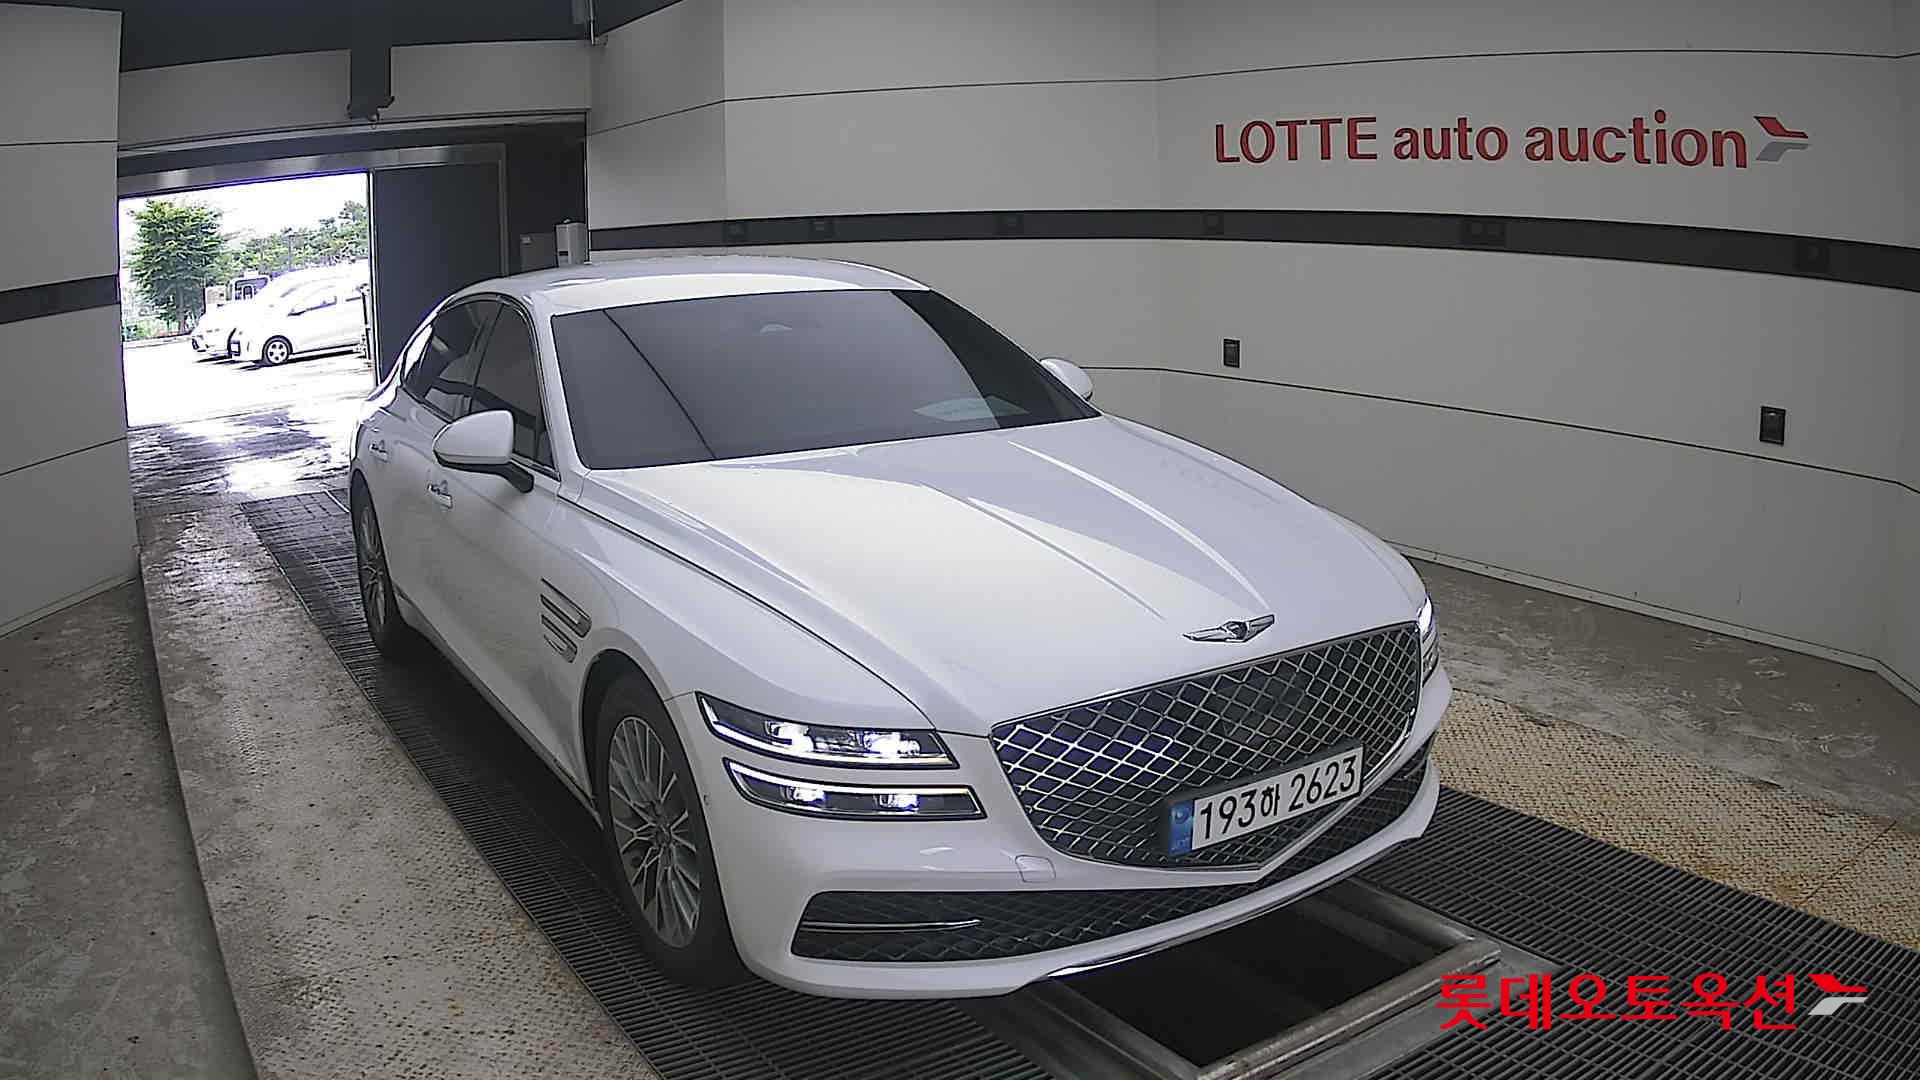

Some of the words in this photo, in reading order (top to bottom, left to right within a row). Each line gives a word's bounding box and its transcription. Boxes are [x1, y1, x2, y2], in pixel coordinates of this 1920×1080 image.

[1214, 116, 1378, 164] LOTTE
[1393, 116, 1509, 162] auto
[1524, 109, 1748, 169] auction
[1200, 783, 1281, 840] 193하
[1288, 754, 1358, 813] 2623
